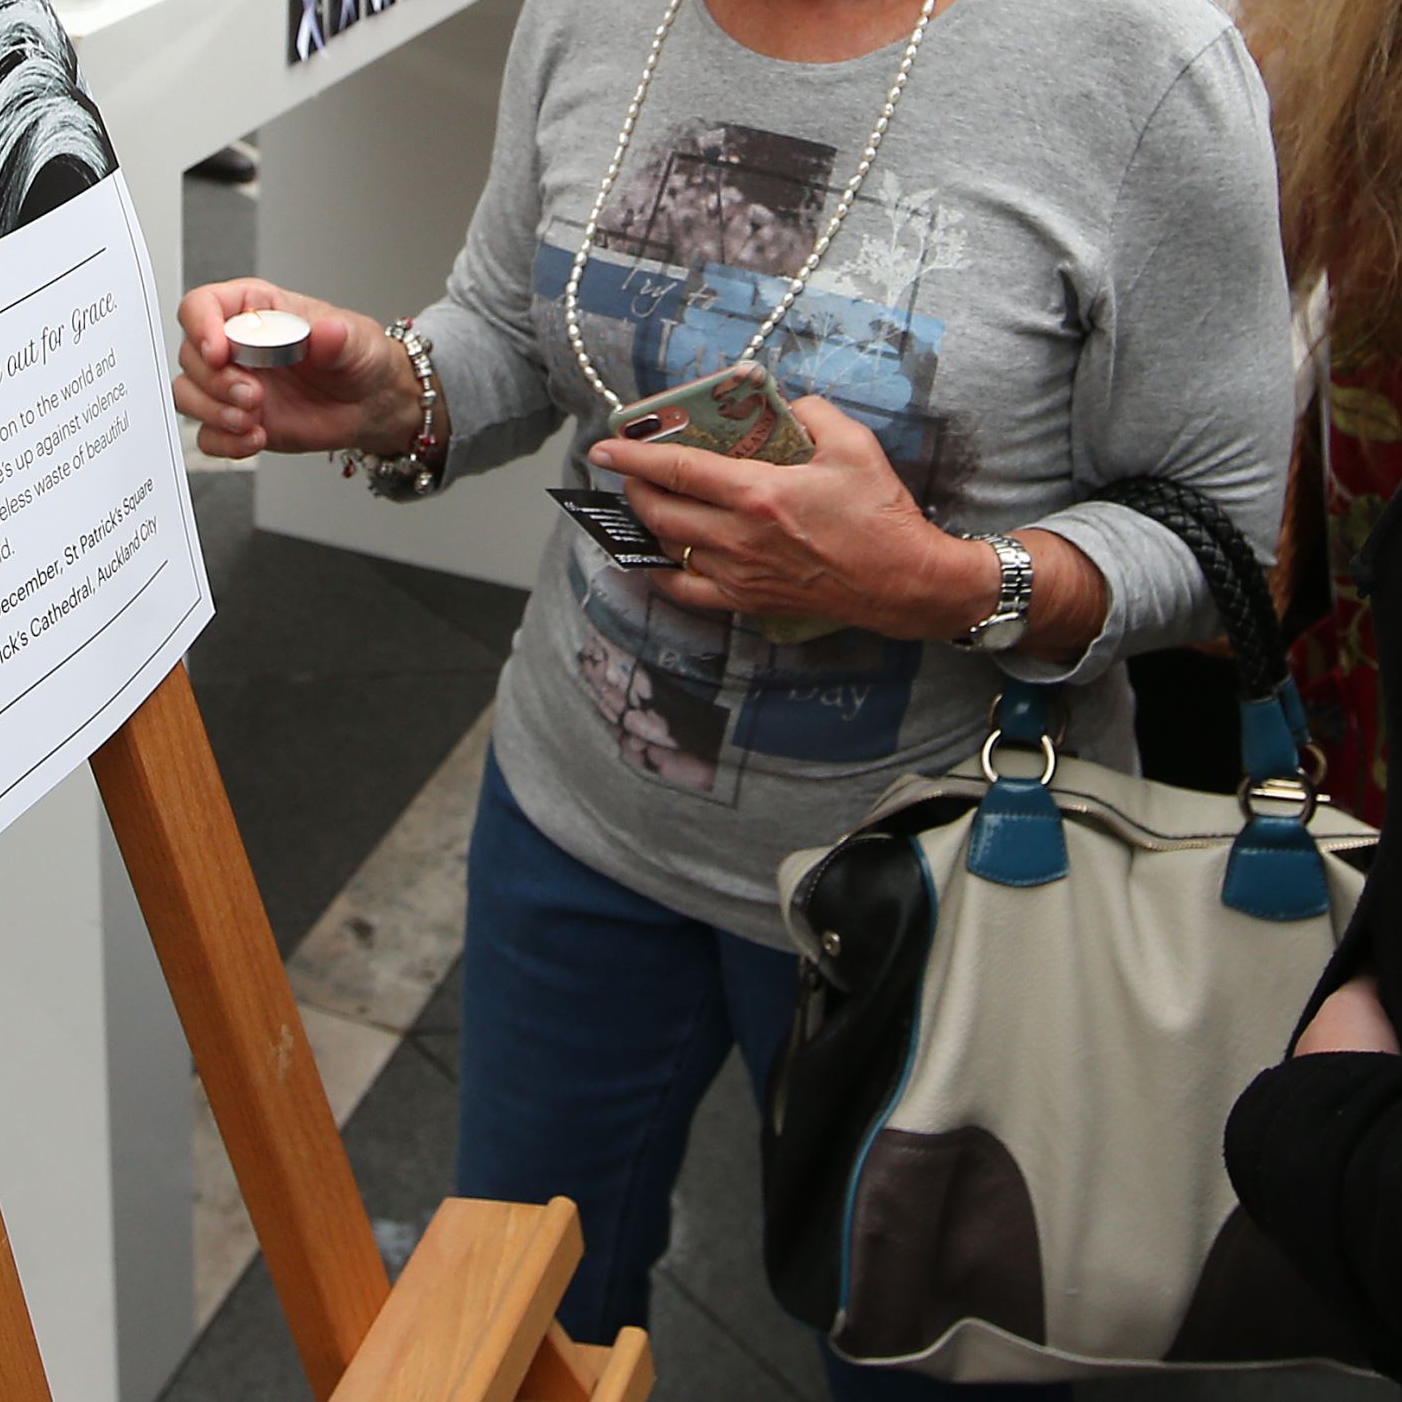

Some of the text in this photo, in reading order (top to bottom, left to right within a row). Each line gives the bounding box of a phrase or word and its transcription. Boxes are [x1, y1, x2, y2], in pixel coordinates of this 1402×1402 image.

[6, 338, 40, 378] out
[40, 323, 65, 366] for
[71, 292, 118, 346] Grace.
[14, 449, 34, 471] up
[35, 413, 82, 458] against
[81, 382, 129, 425] violence,
[19, 409, 35, 429] to
[36, 393, 60, 418] the
[60, 363, 95, 402] world
[95, 347, 117, 378] and
[32, 461, 72, 497] waste
[72, 444, 85, 470] of
[84, 409, 130, 460] beautiful
[63, 543, 80, 566] St
[79, 506, 124, 555] Patrick's
[122, 477, 154, 516] Square
[29, 575, 96, 638] Cathedral,
[97, 529, 141, 588] Auckland
[139, 516, 157, 542] City
